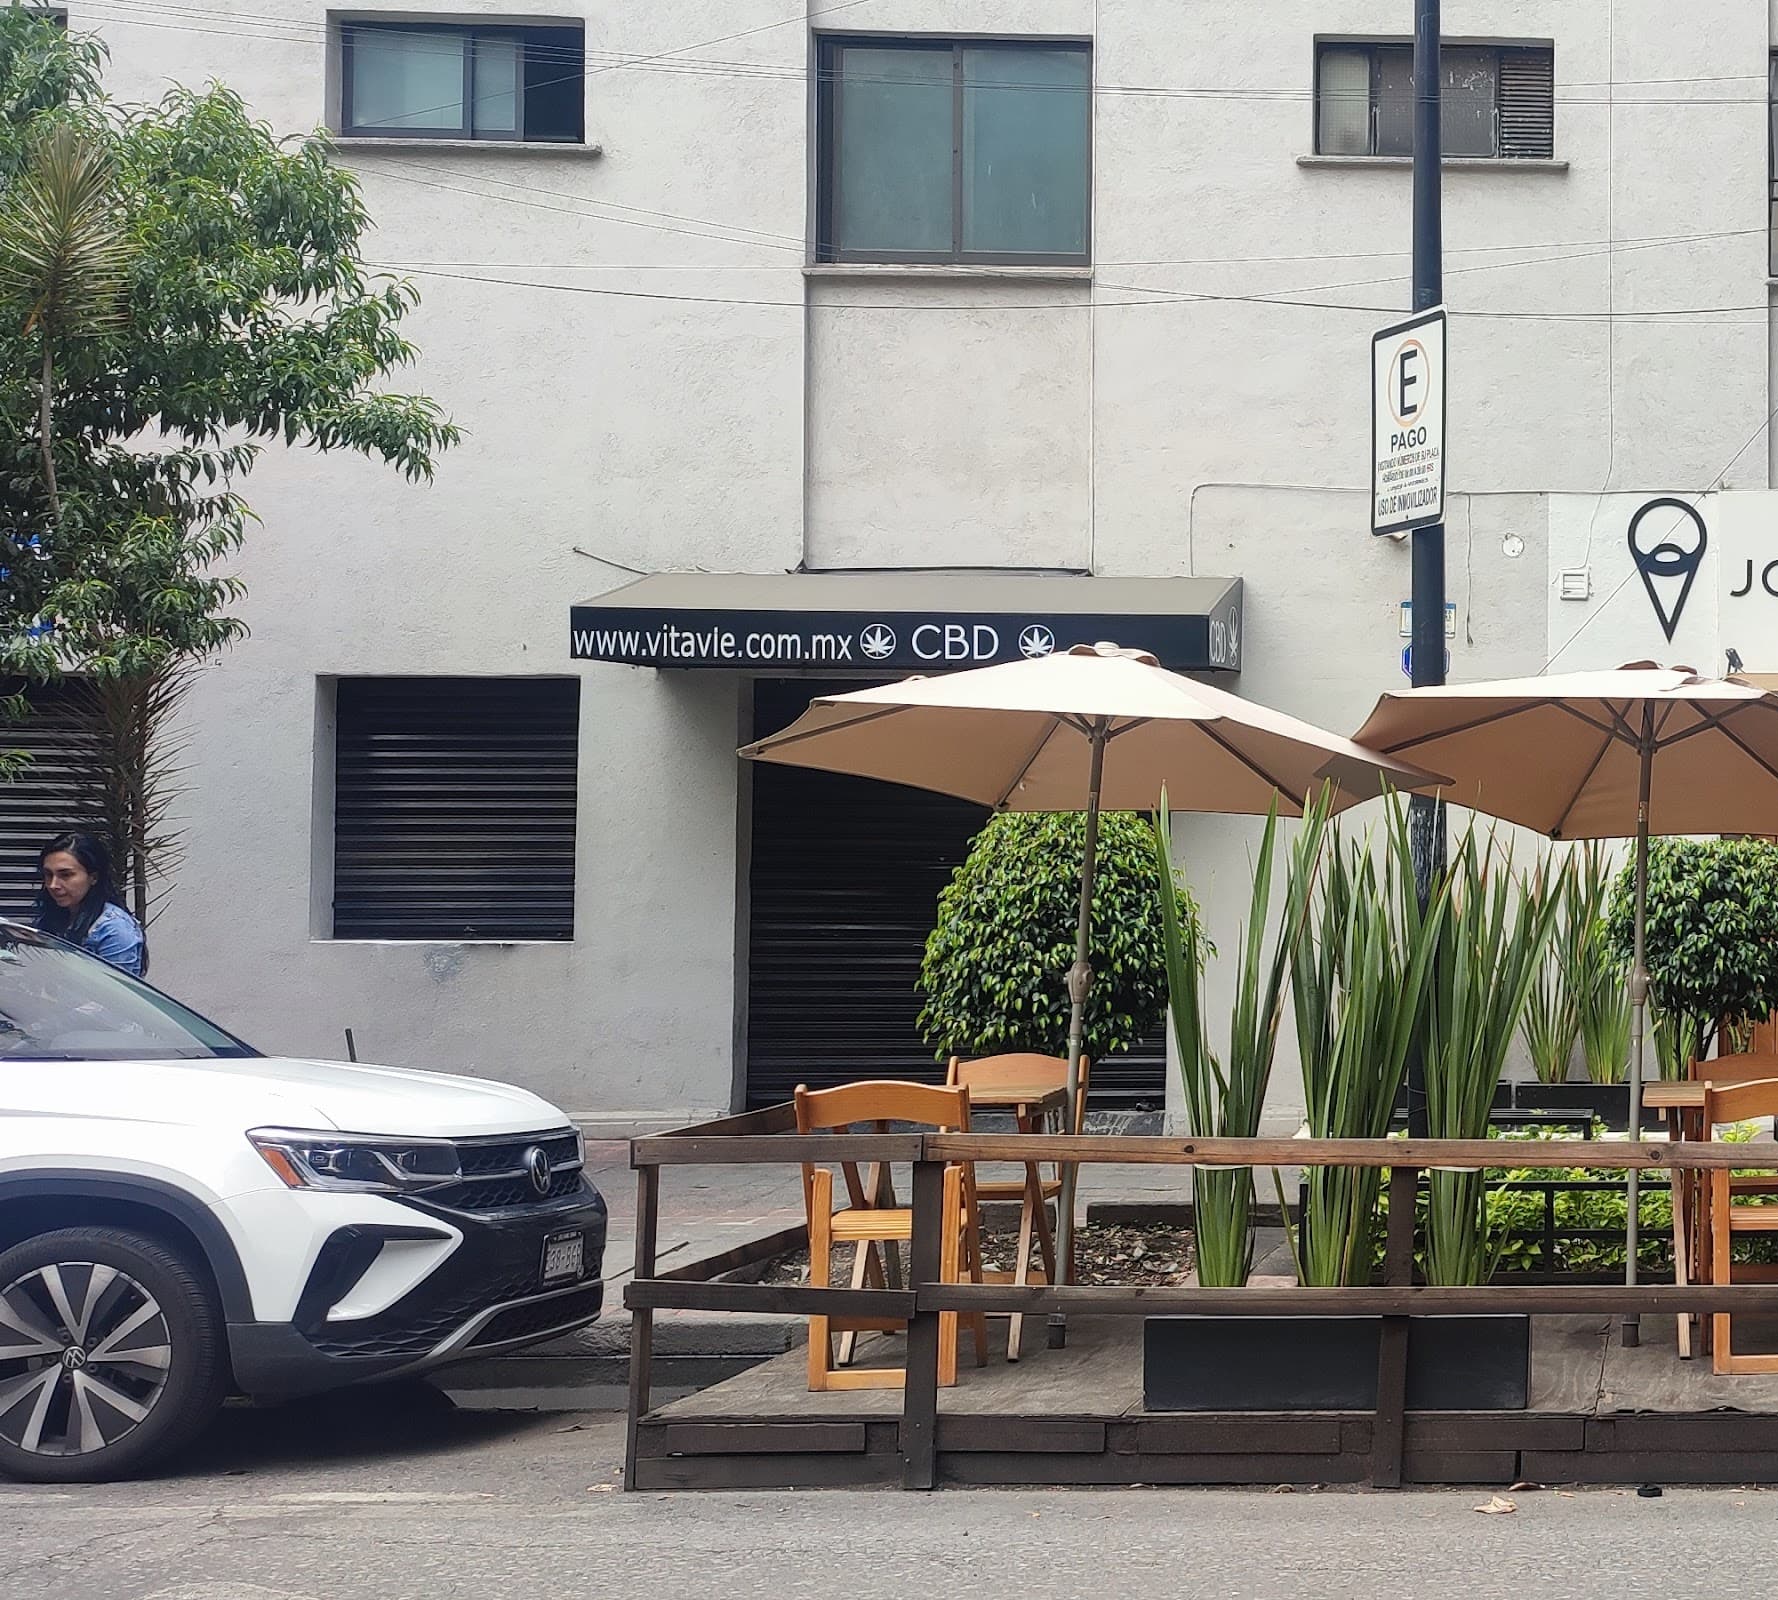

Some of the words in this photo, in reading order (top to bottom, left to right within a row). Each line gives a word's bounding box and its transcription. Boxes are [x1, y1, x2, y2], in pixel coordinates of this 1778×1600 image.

[1400, 349, 1418, 417] E
[1391, 426, 1427, 453] PAGO
[1378, 497, 1389, 517] USO
[1389, 495, 1397, 514] DE
[1398, 486, 1438, 512] INMOVILIZADOR
[573, 624, 853, 660] www.vitavle.com.mx
[911, 624, 999, 660] CBD
[1210, 620, 1226, 663] CBD
